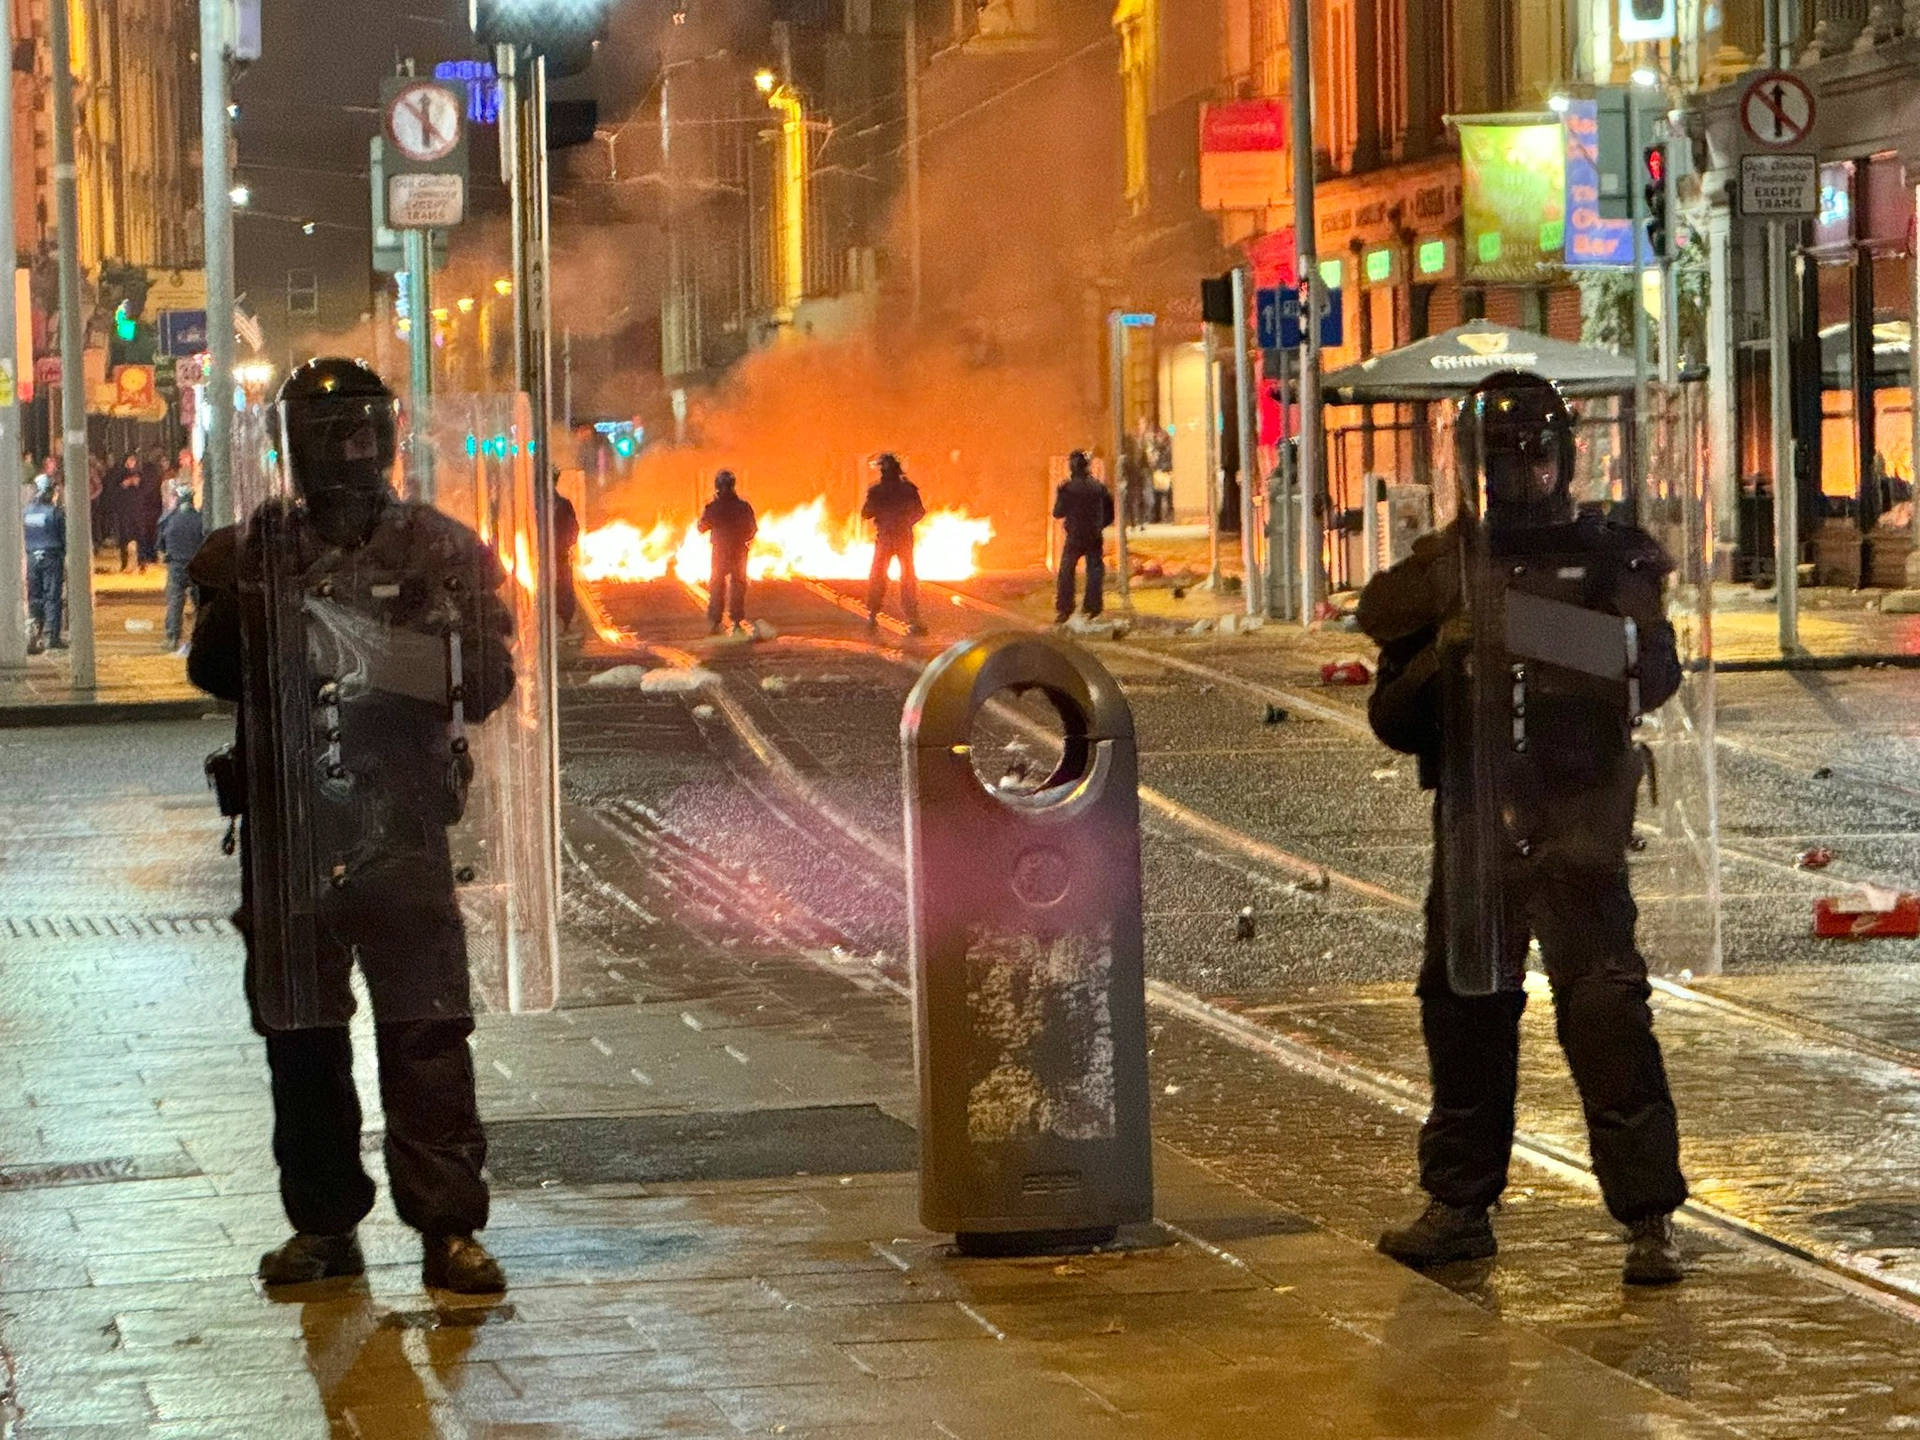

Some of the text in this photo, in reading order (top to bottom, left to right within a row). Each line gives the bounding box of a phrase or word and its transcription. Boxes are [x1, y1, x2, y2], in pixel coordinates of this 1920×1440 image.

[1755, 187, 1803, 197] EXCEPT
[1756, 199, 1801, 208] TRAMS
[408, 211, 445, 220] TRAMS
